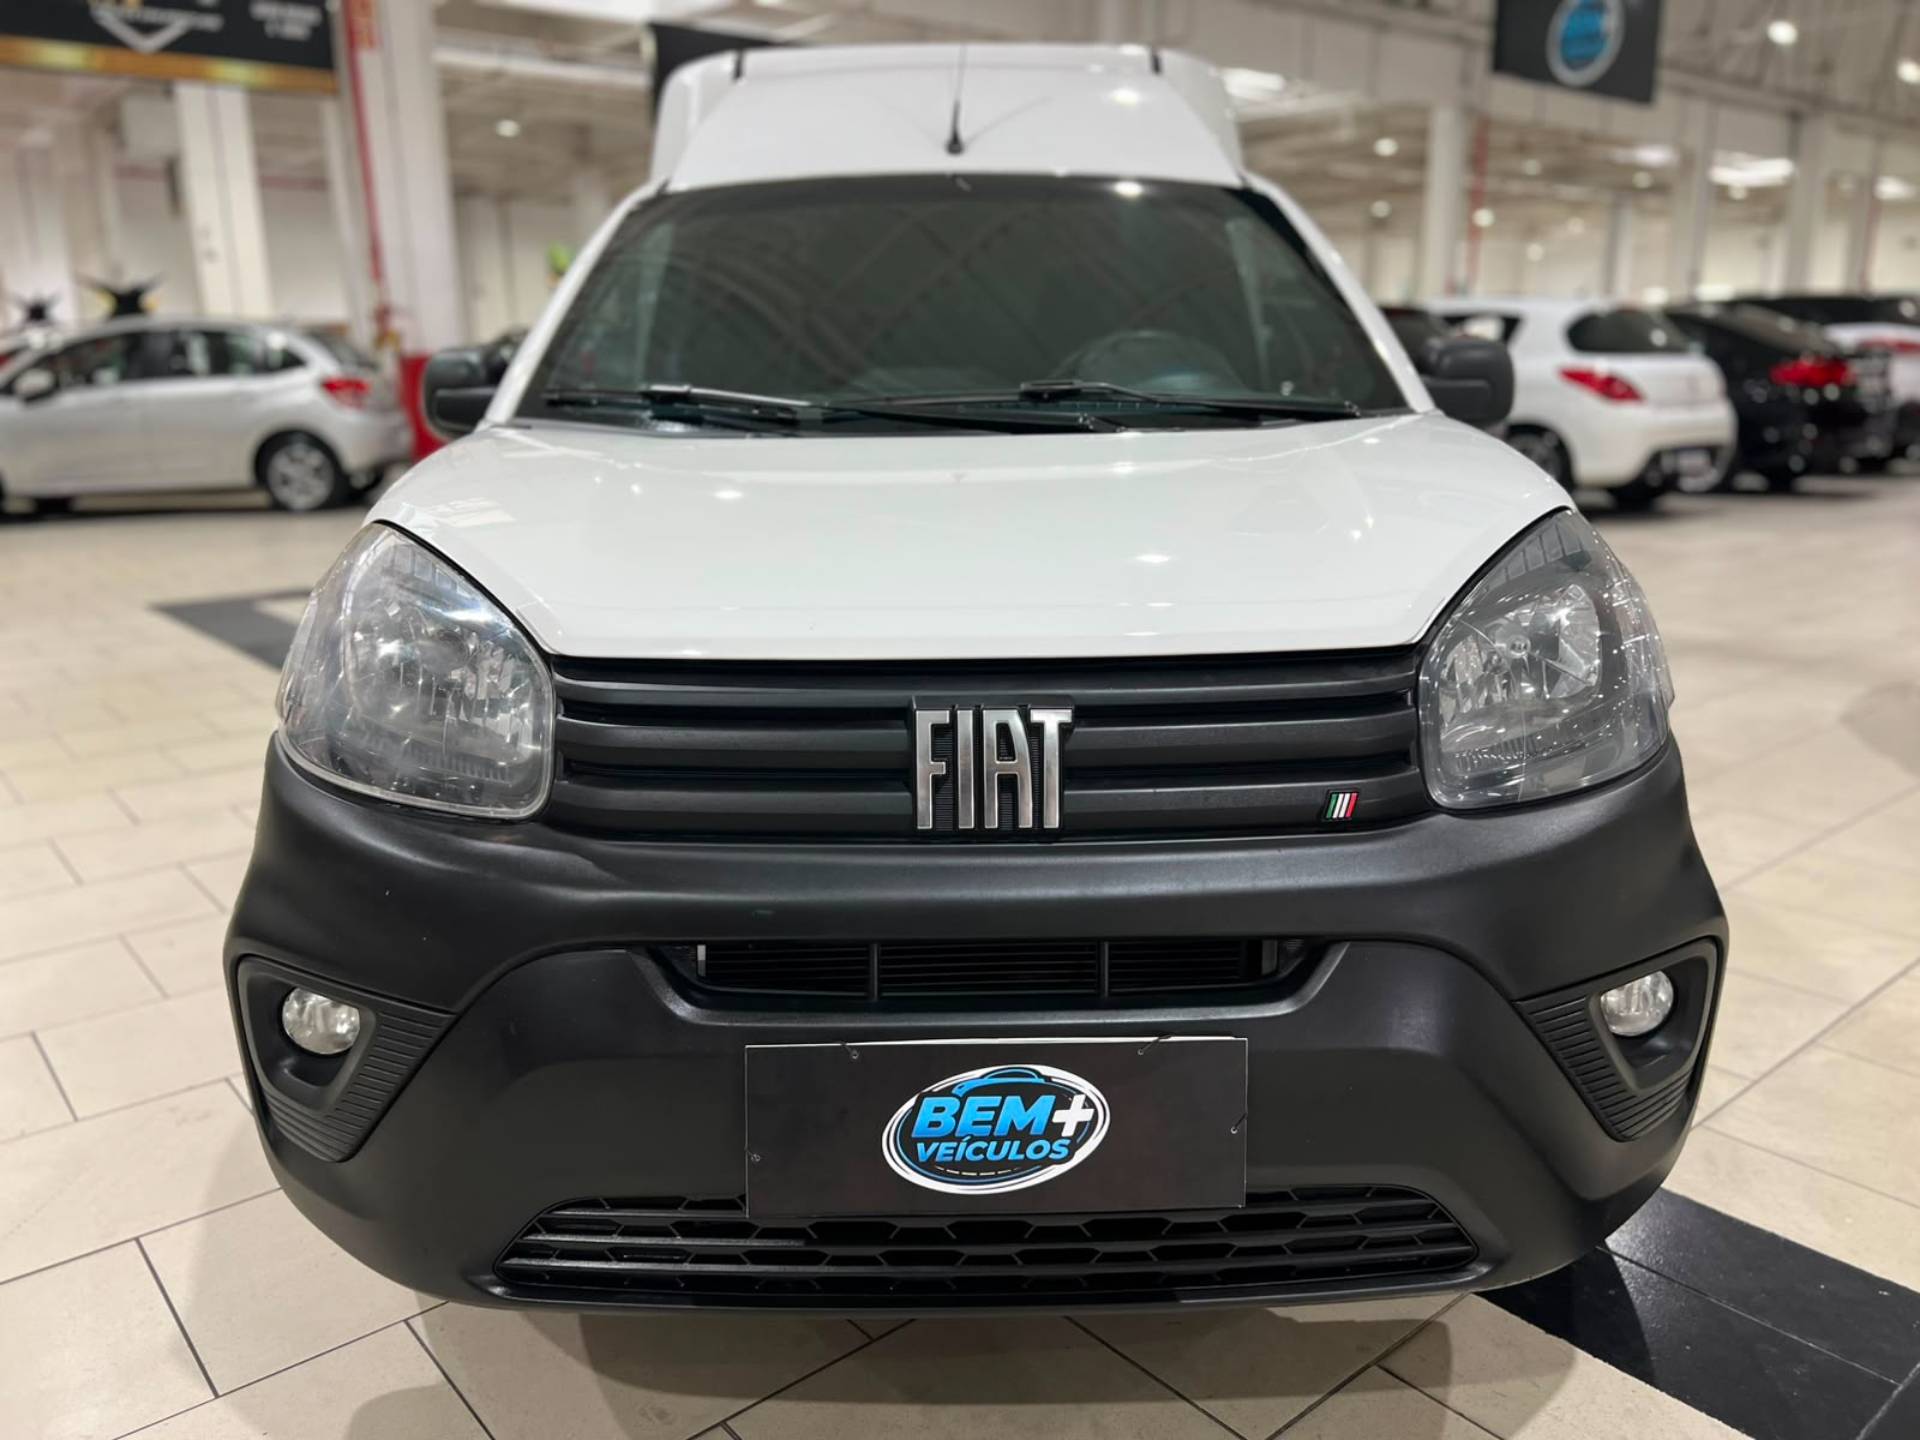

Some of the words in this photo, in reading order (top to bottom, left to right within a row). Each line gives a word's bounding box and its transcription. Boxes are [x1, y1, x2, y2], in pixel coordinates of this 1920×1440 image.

[915, 708, 1073, 830] FIAT
[911, 1094, 1095, 1138] BEM+
[917, 1135, 1071, 1163] VEÍCULOS
